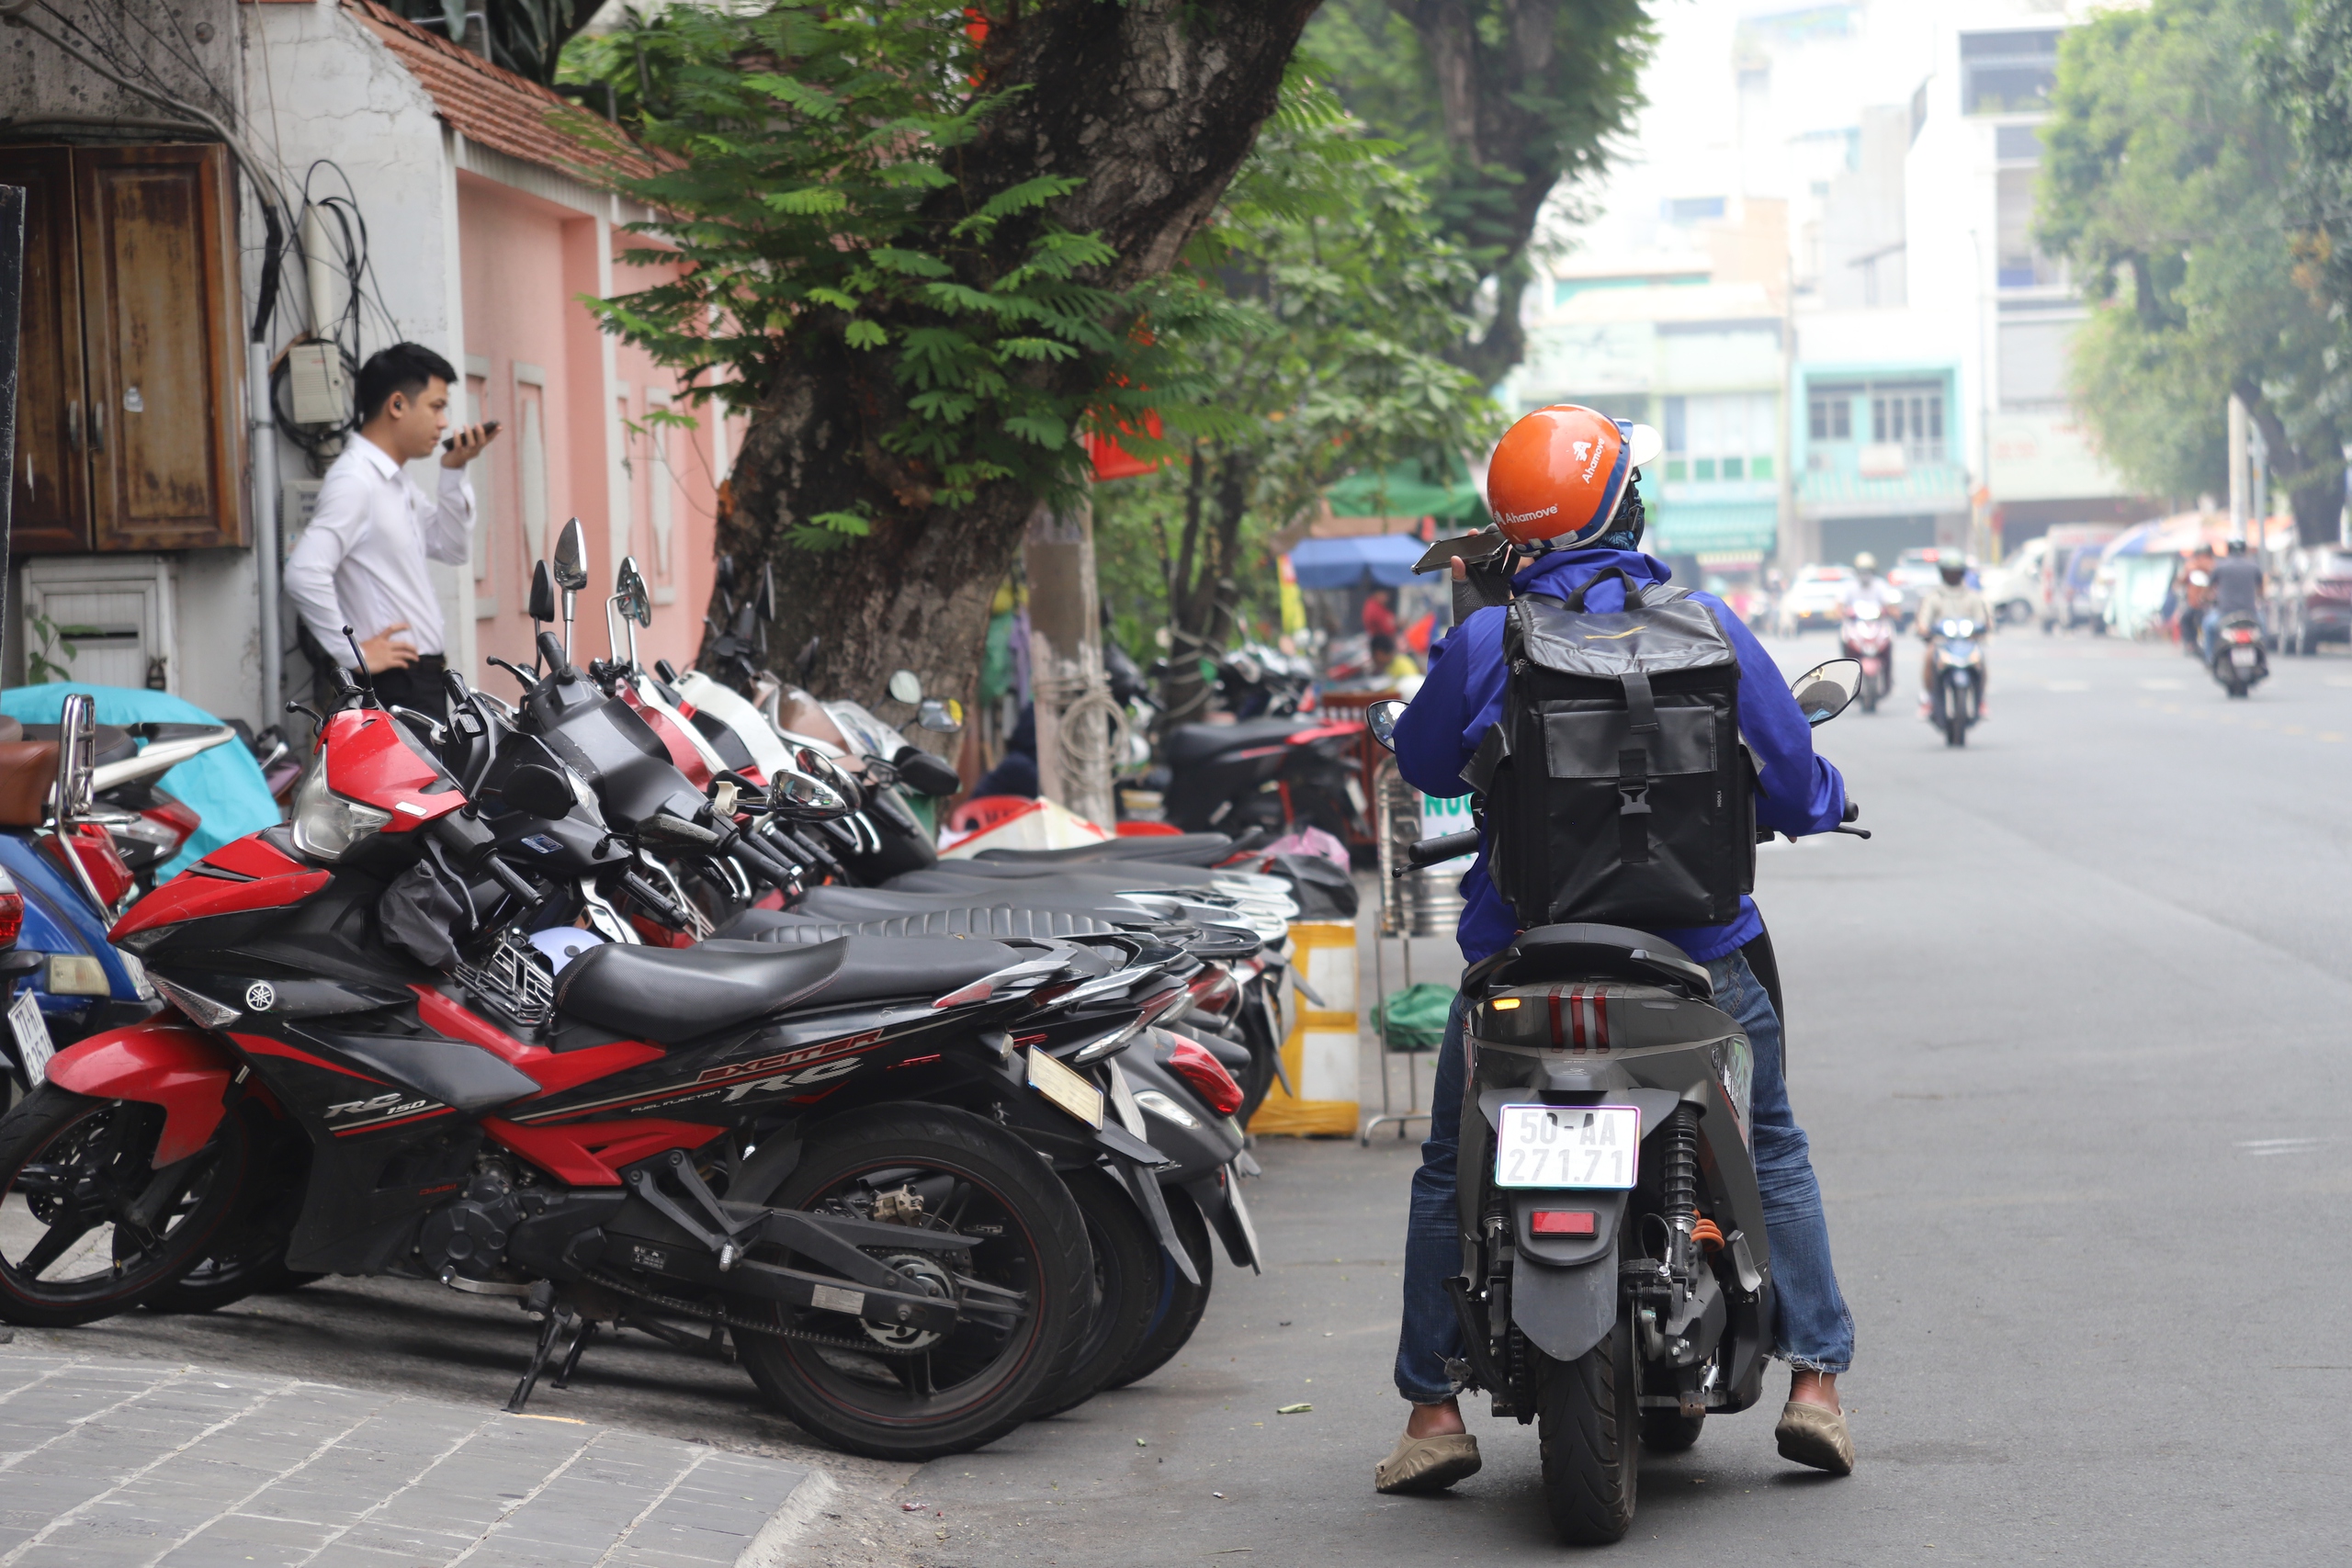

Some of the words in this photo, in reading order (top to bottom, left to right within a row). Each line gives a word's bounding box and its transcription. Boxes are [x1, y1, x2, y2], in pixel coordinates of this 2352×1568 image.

[1581, 438, 1605, 484] Ahamove
[1505, 504, 1558, 525] Ahamove
[695, 1028, 885, 1083] EXCITER
[721, 1057, 864, 1102] RC
[323, 1092, 402, 1119] RC
[387, 1100, 426, 1115] 150
[630, 1102, 662, 1112] FUEL
[662, 1089, 720, 1108] INJECTION
